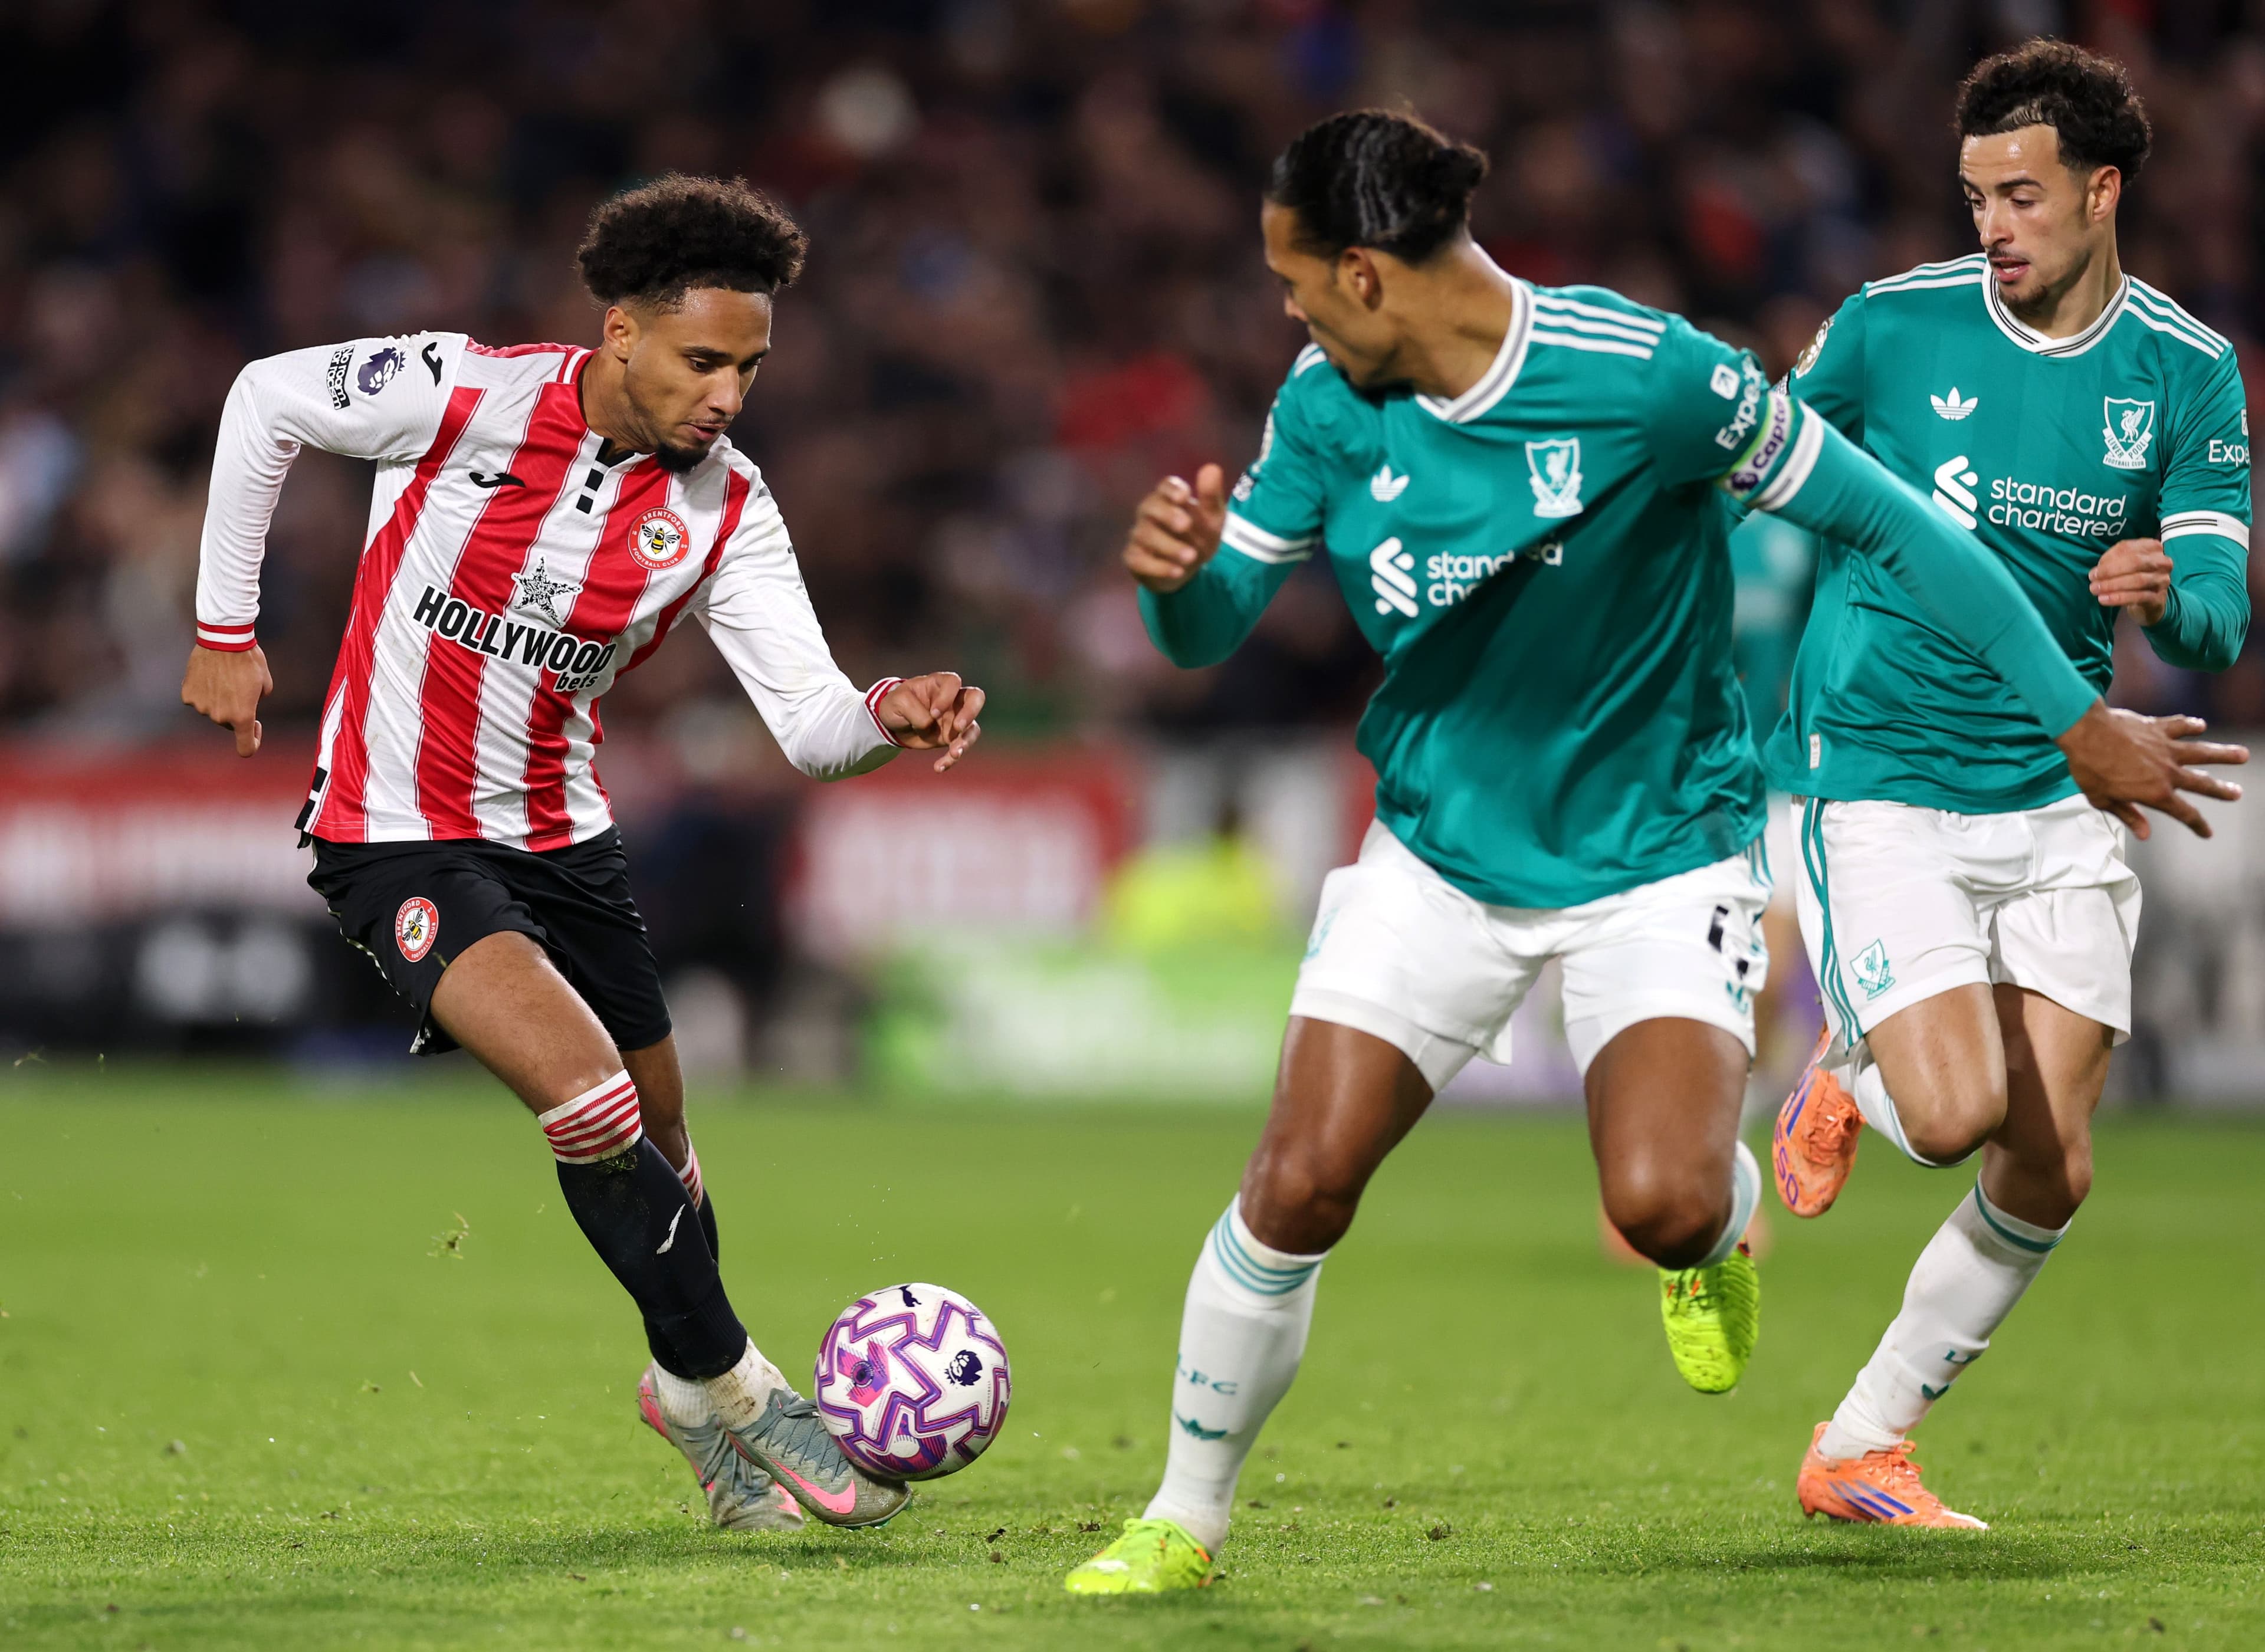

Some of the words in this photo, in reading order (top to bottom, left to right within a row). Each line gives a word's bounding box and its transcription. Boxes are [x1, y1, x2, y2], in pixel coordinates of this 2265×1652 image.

[341, 346, 354, 364] No
[327, 367, 342, 409] racism
[334, 365, 347, 402] room
[1752, 398, 1785, 469] Capt
[2108, 437, 2124, 458] LIVER
[2128, 441, 2146, 459] POOL
[2105, 457, 2129, 467] FOOTBALL
[1990, 477, 2126, 517] standard
[642, 511, 685, 532] BRENTFORD
[1988, 504, 2126, 537] chartered
[632, 547, 660, 567] FOOTBALL
[662, 557, 679, 566] CLUB
[412, 585, 617, 674] HOLLYWOOD
[554, 671, 599, 691] bets
[397, 900, 421, 937] BRENTFORD
[411, 941, 431, 958] FOOTBALL
